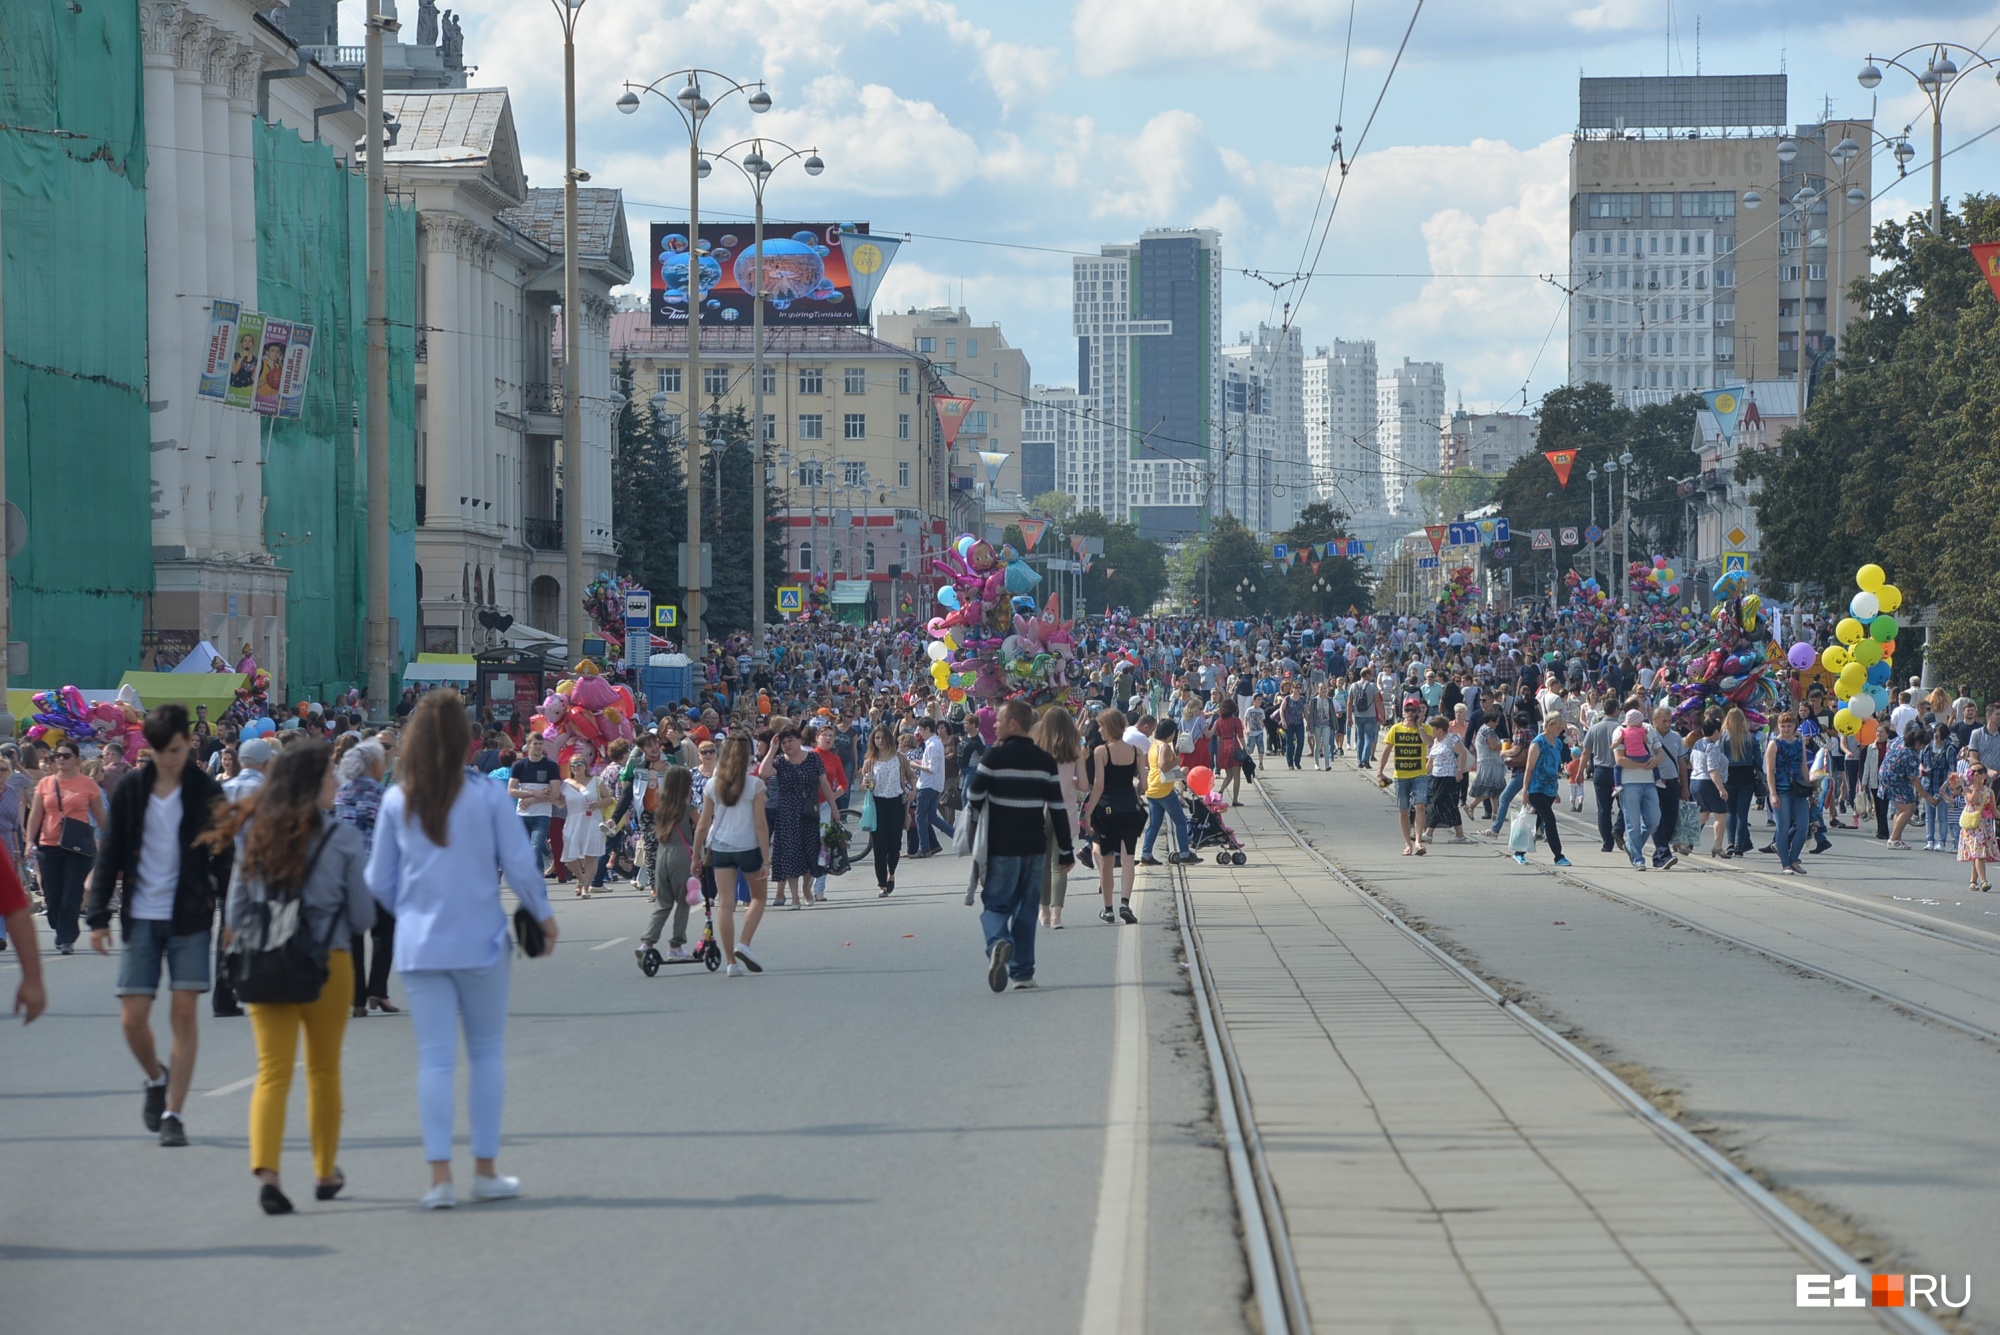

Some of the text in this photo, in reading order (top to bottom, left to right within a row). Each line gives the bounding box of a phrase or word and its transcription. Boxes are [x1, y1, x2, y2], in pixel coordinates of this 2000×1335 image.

[1592, 149, 1763, 179] SAMSUNG
[242, 316, 262, 325] ПУТЬ
[660, 306, 705, 319] Tunia
[267, 325, 287, 335] ПУТЬ
[206, 336, 219, 374] КОЛЛЕДЖ
[283, 358, 293, 394] КОЛЛЕДЖ
